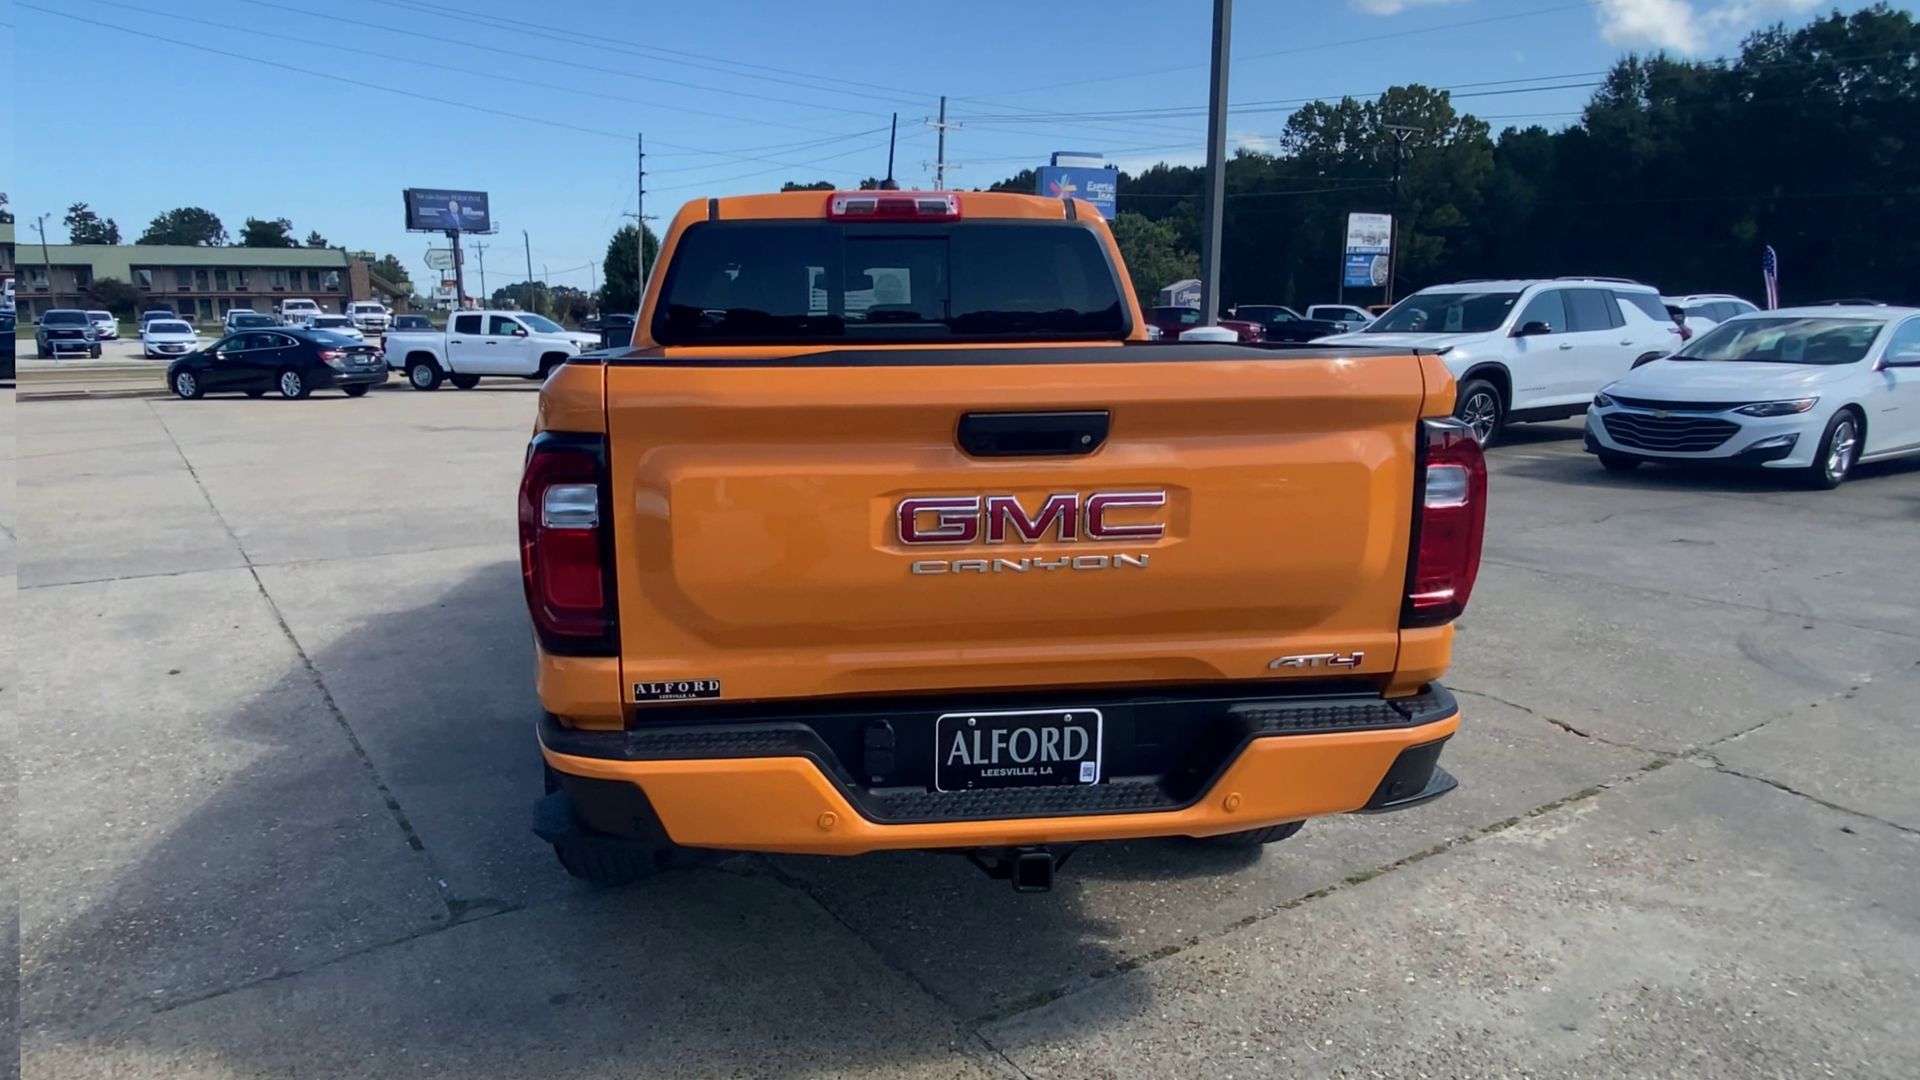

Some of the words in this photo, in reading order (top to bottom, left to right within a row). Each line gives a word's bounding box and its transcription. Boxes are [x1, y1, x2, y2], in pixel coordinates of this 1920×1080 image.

[897, 491, 1165, 544] GMC
[912, 554, 1148, 574] CANYON
[1268, 652, 1365, 670] AT4
[636, 681, 719, 694] ALFORD
[947, 726, 1089, 765] ALFORD
[981, 767, 1037, 777] LEESVILLE,
